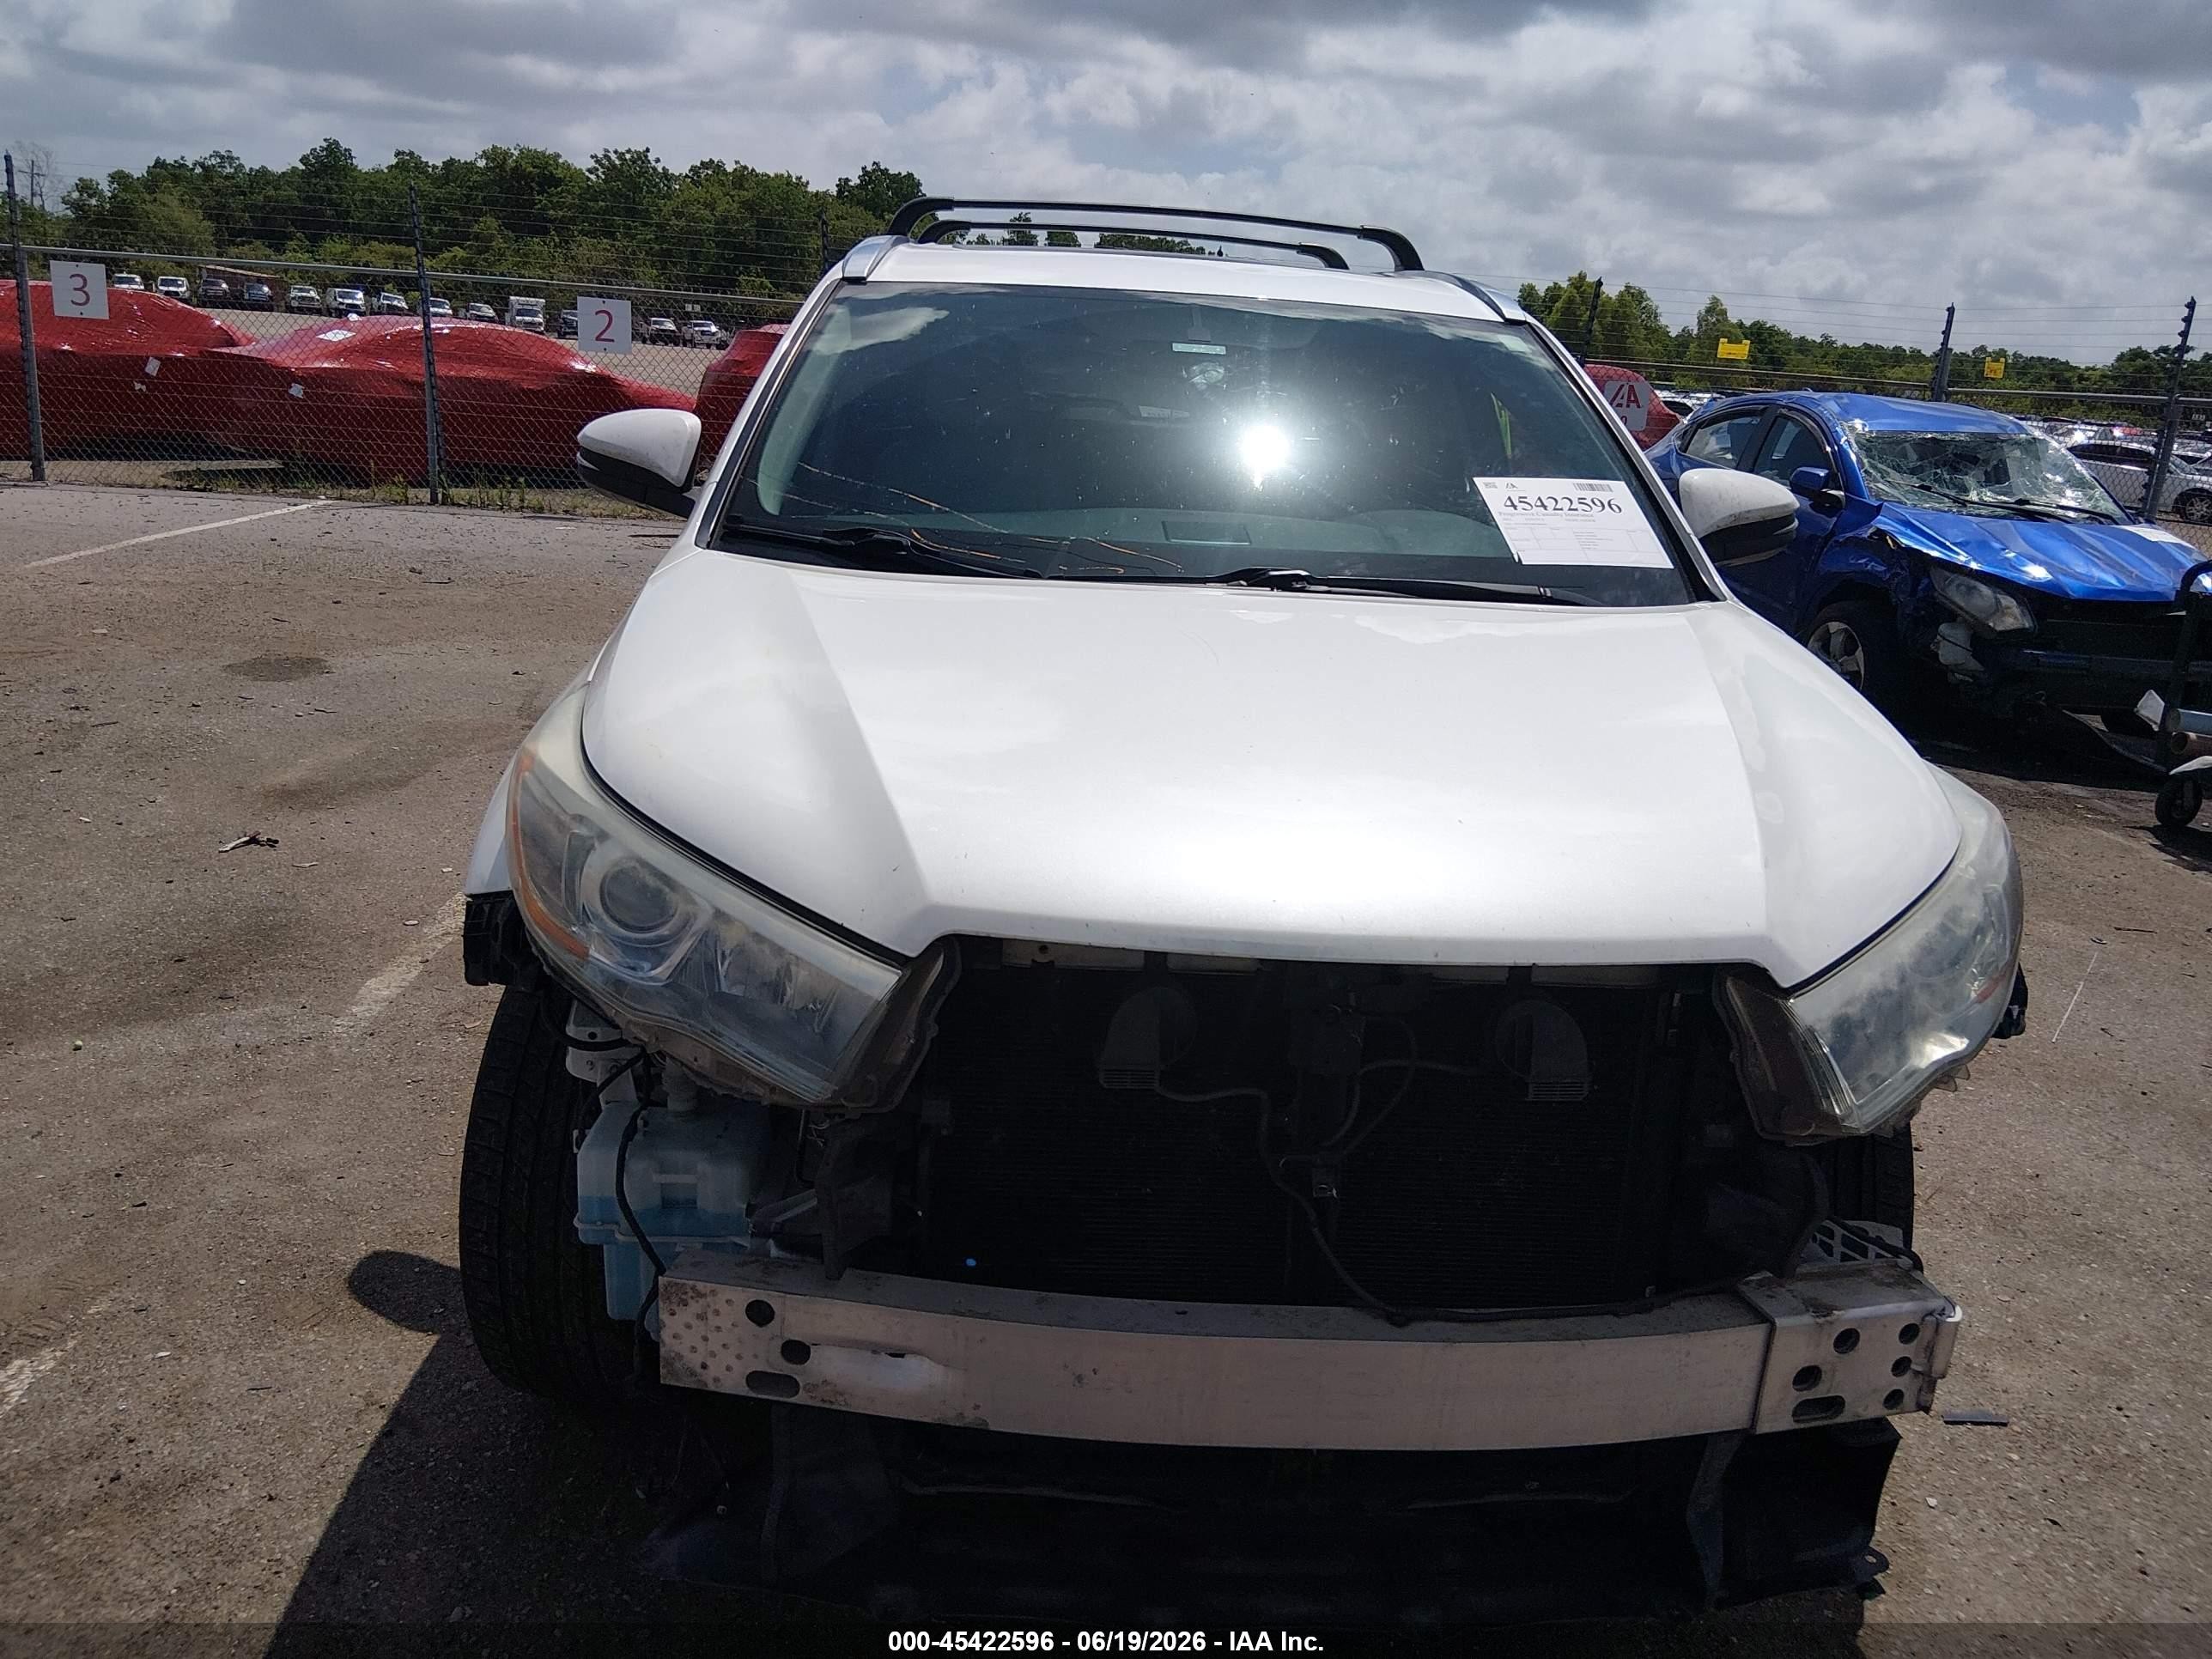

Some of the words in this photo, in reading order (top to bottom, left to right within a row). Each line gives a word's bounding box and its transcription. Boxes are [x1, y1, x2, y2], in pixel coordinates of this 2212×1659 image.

[70, 274, 90, 307] 3
[595, 309, 615, 343] 2
[1504, 495, 1622, 514] 45422596
